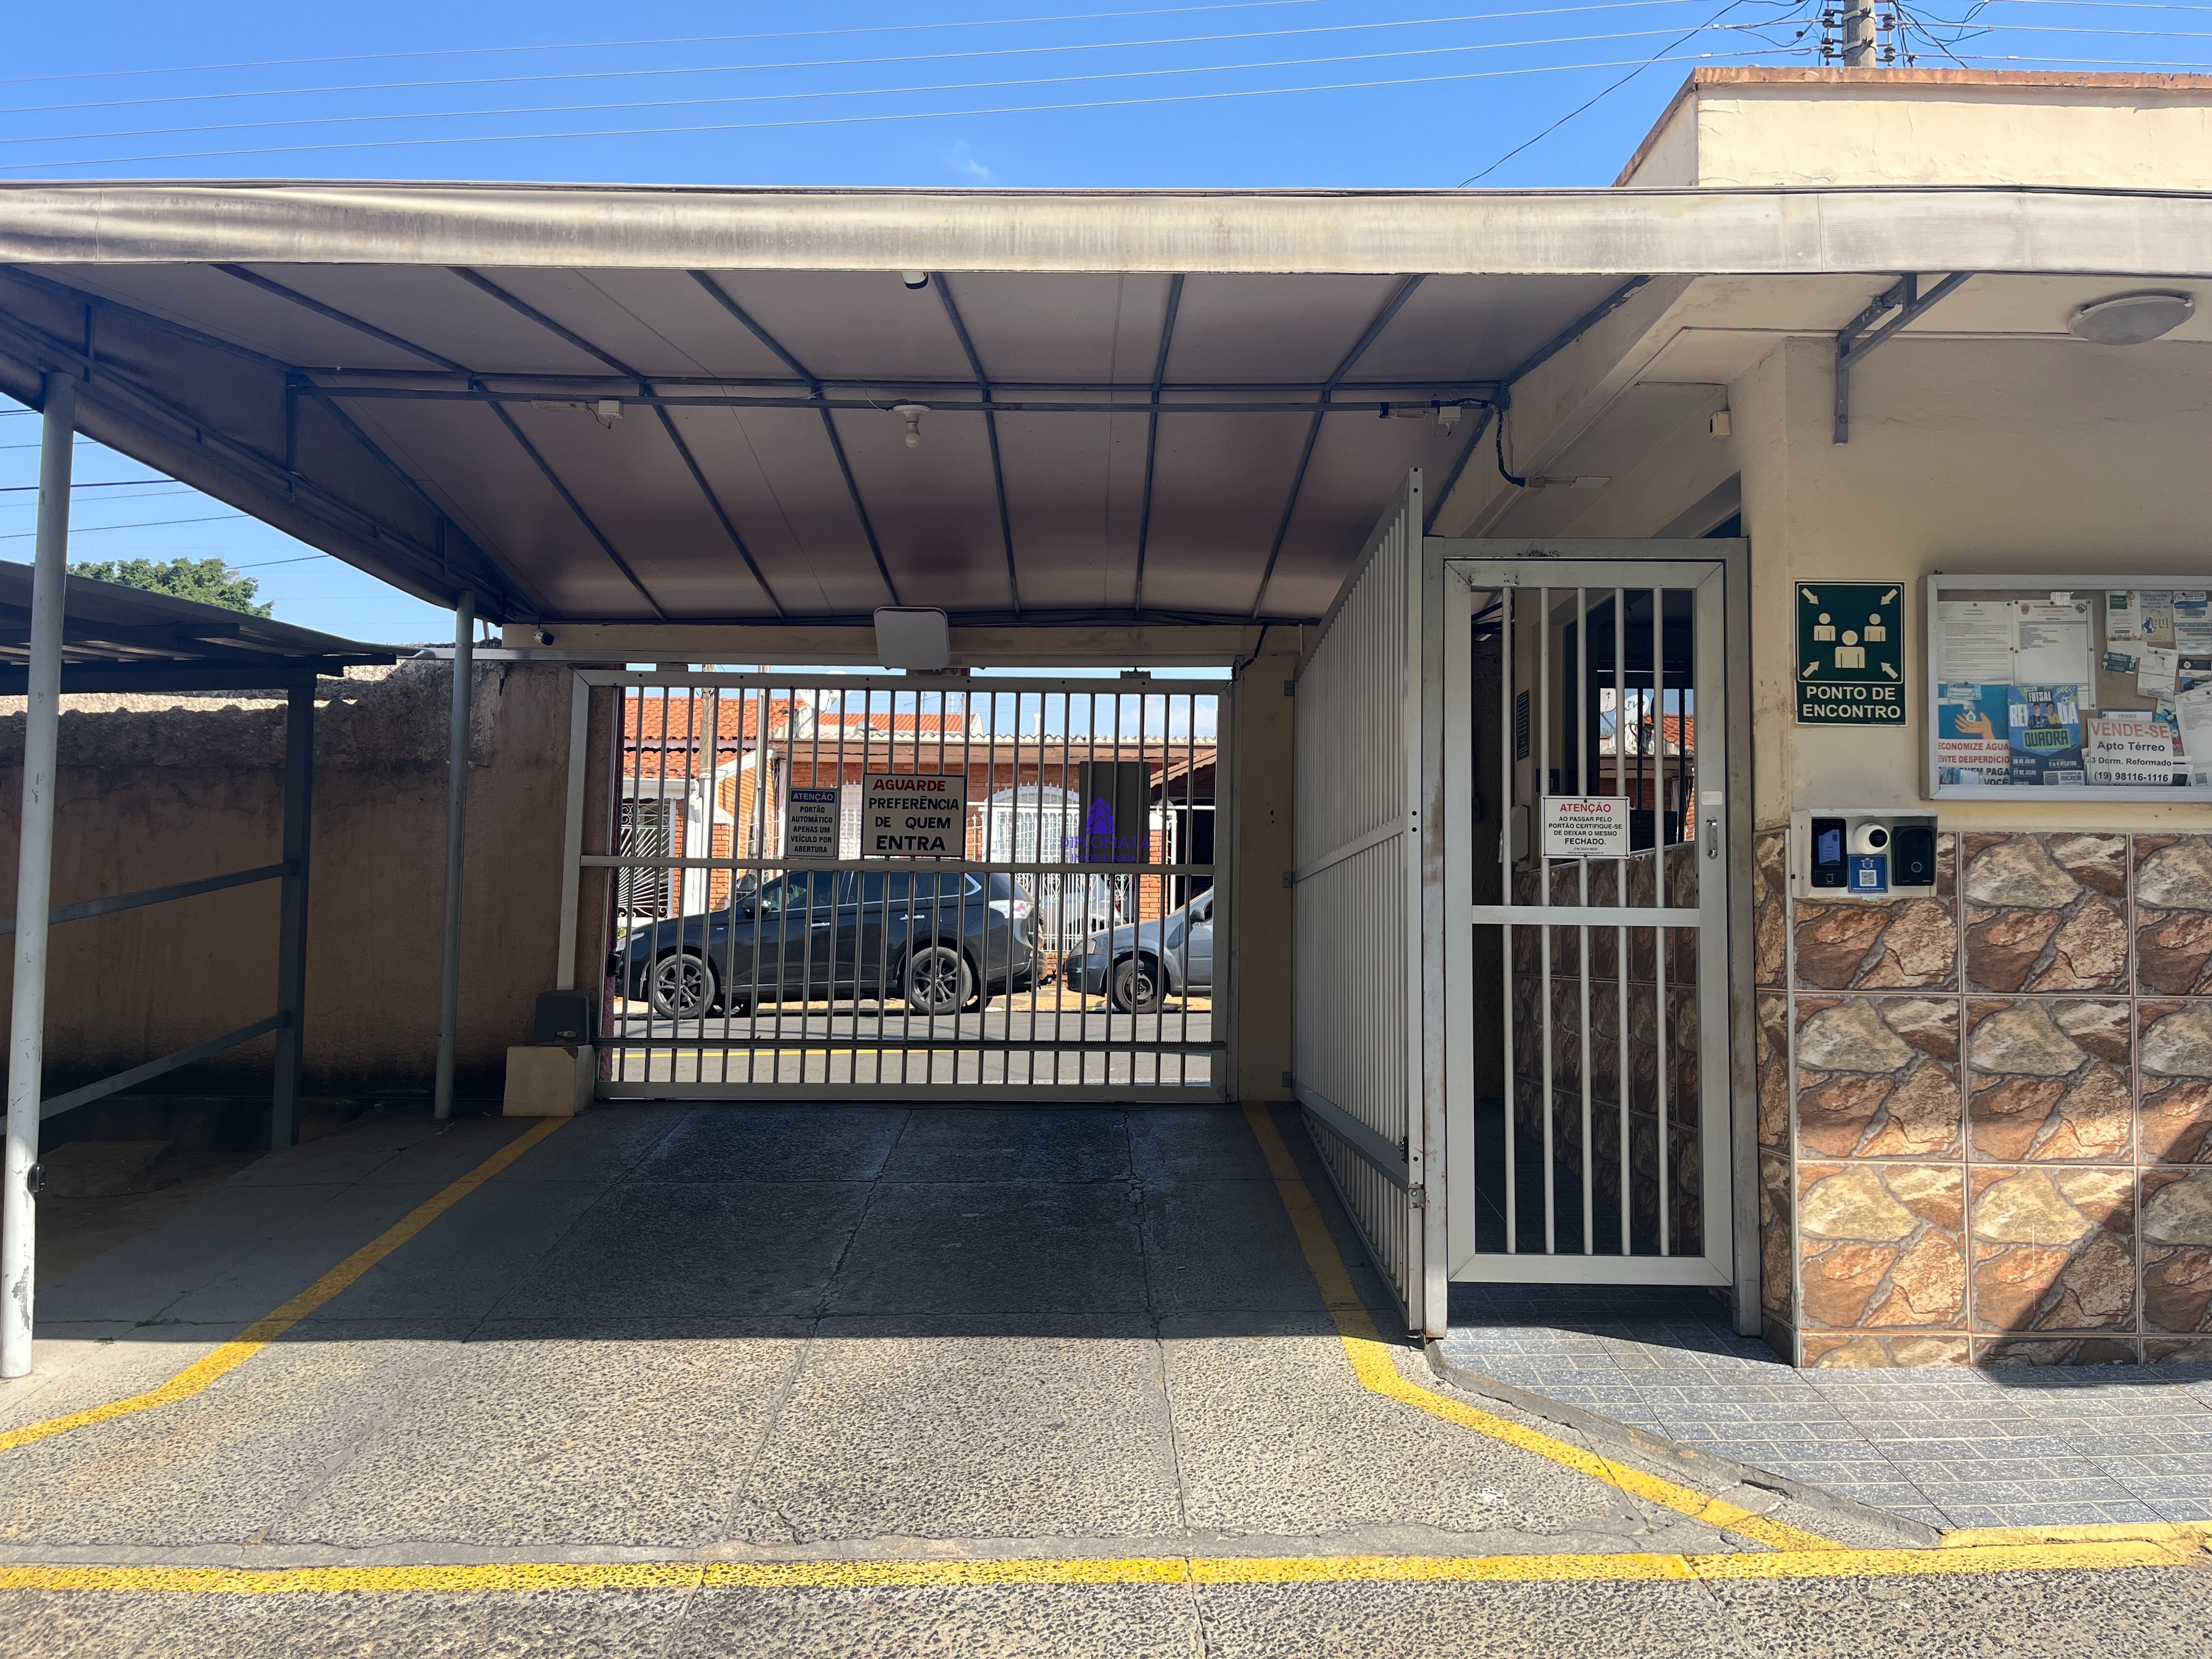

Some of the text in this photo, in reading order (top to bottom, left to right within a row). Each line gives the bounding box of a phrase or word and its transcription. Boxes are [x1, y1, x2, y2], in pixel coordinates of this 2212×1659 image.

[1807, 686, 1895, 701] PONTO DE
[2029, 691, 2052, 702] FUTSAL
[1803, 704, 1901, 719] ENCONTRO
[2009, 704, 2028, 727] REI
[2091, 721, 2170, 738] VENDE-SE
[2024, 730, 2069, 747] QUADRA
[1938, 741, 2009, 751] ECONOMIZE ÁGUA
[2097, 741, 2124, 752] Apto
[2128, 742, 2165, 752] Térreo
[1938, 754, 2010, 764] EVITE DESPERDÍCIO
[2126, 758, 2172, 766] Reformado
[1987, 768, 2010, 776] PAGA
[2094, 771, 2169, 782] (19) 98116-1116
[872, 778, 946, 792] AGUARDE
[793, 792, 833, 802] ATENÇÃO
[868, 795, 959, 810] PREFERÊNCIA
[800, 805, 825, 813] PORTÃO
[1560, 802, 1611, 814] ATENÇÃO
[791, 815, 833, 823] AUTOMÁTICO
[875, 816, 951, 830] DE QUEM
[791, 834, 817, 843] VEÍCULO
[876, 835, 946, 851] ENTRA
